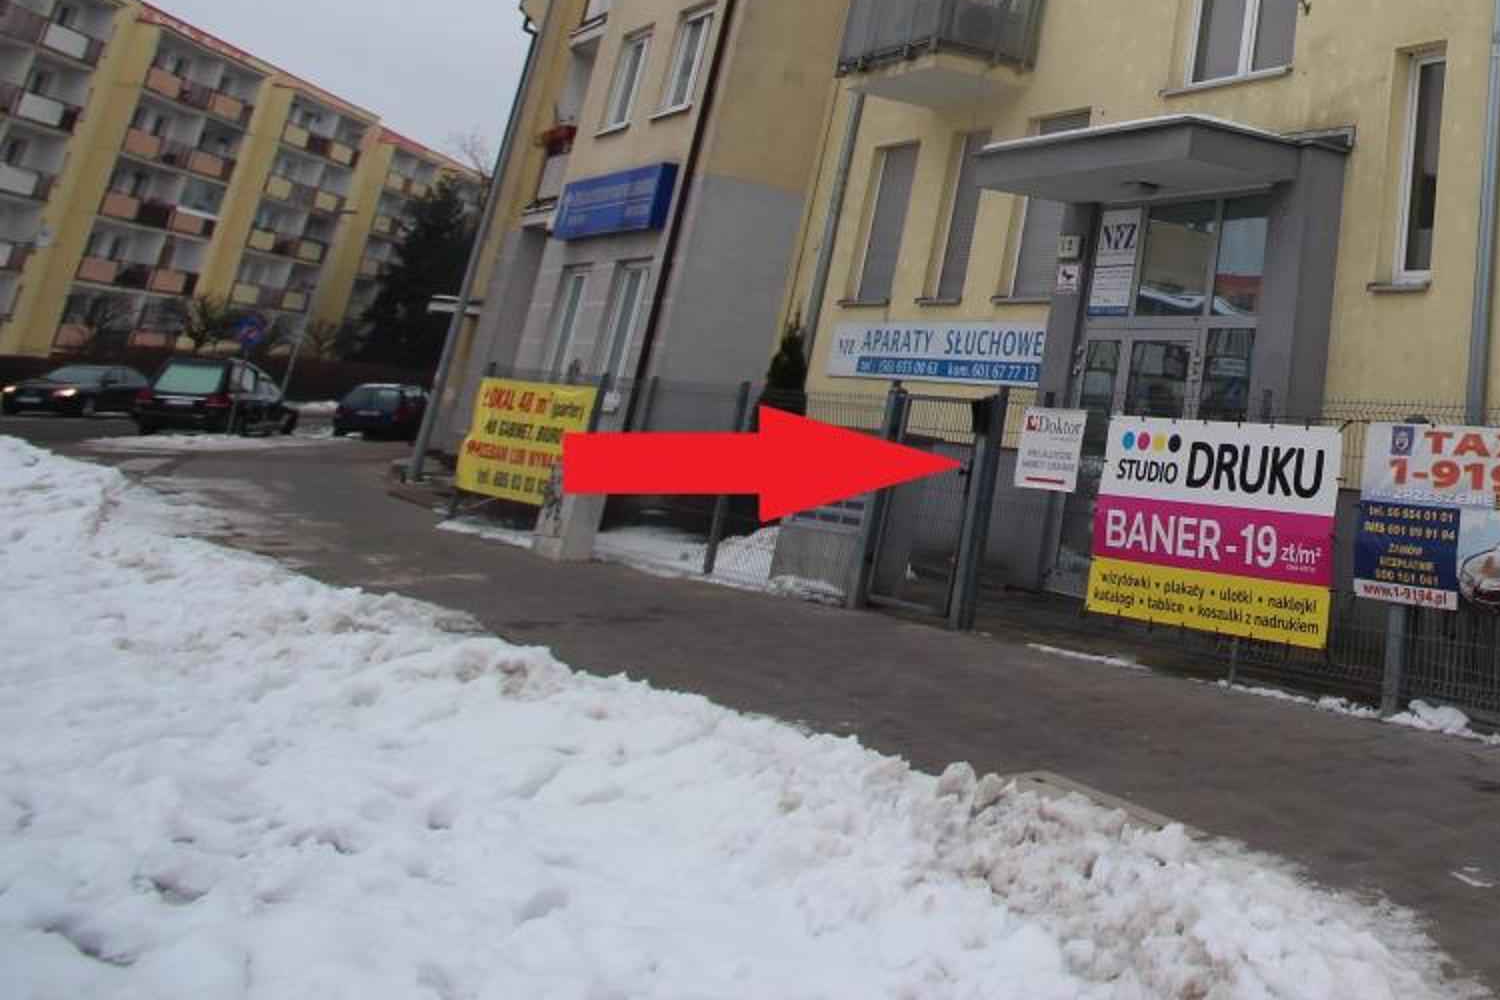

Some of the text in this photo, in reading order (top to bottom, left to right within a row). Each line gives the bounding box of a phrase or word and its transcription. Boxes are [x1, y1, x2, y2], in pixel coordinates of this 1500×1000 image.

[1103, 223, 1137, 250] NFZ
[863, 329, 935, 353] APARATY
[943, 329, 1045, 358] SŁUCHOWE
[1038, 415, 1082, 435] Doktor
[1117, 441, 1325, 498] STUDIO DRUKU
[1105, 509, 1222, 562] BANER
[1241, 524, 1278, 568] 19
[1094, 587, 1135, 606] katalogi
[1147, 596, 1185, 614] tablice
[1197, 604, 1243, 623] koszulki
[1254, 614, 1319, 634] nadrukiem
[1163, 581, 1205, 600] plakaty
[1220, 589, 1252, 604] ulotki
[1268, 595, 1317, 614] naklejki
